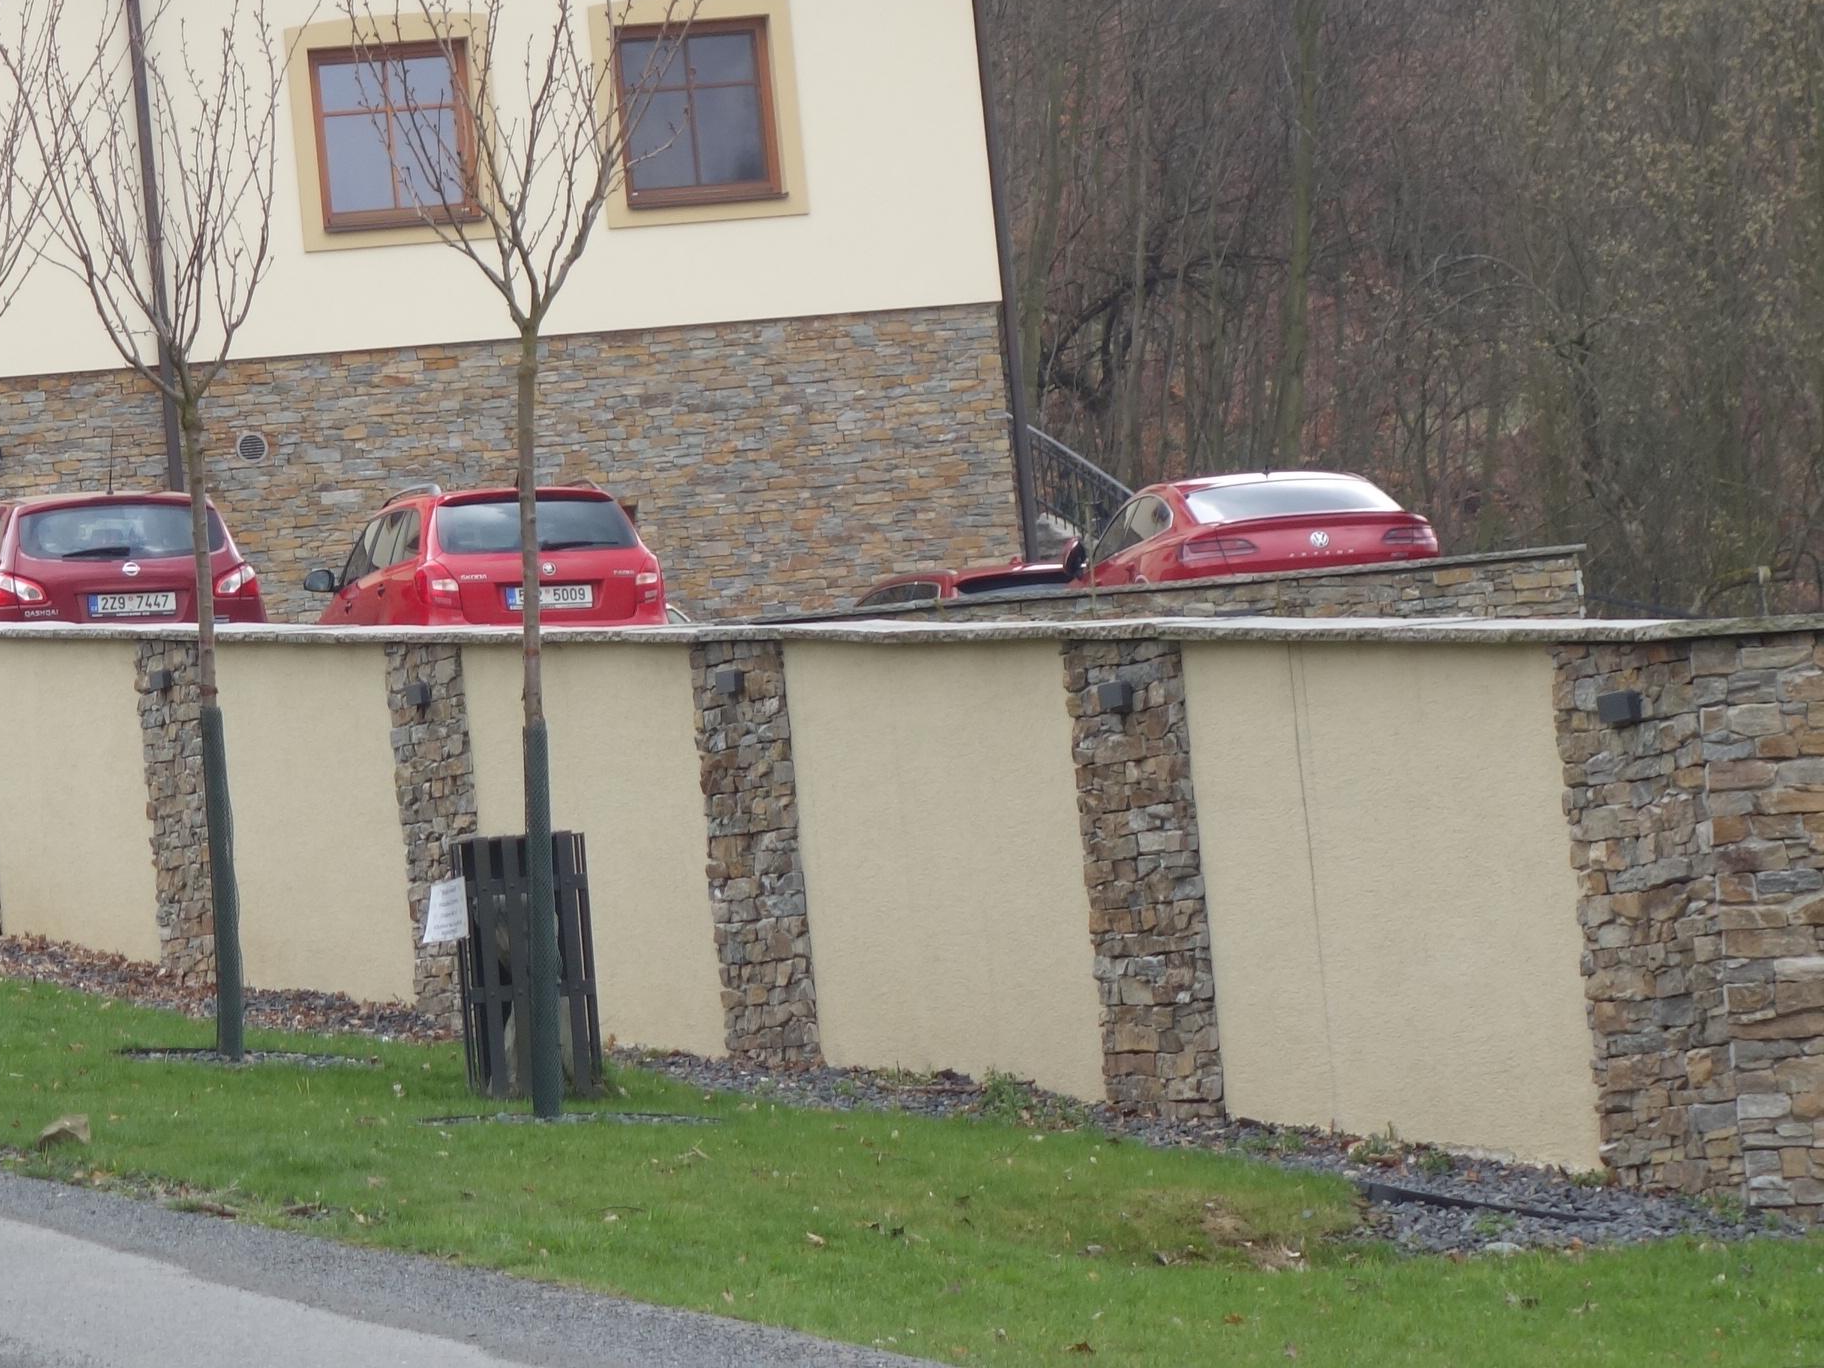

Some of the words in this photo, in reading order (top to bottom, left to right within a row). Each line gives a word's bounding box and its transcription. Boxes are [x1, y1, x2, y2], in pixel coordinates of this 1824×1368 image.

[552, 587, 586, 601] 5009
[101, 595, 126, 611] 2Z9
[136, 594, 169, 609] 7447
